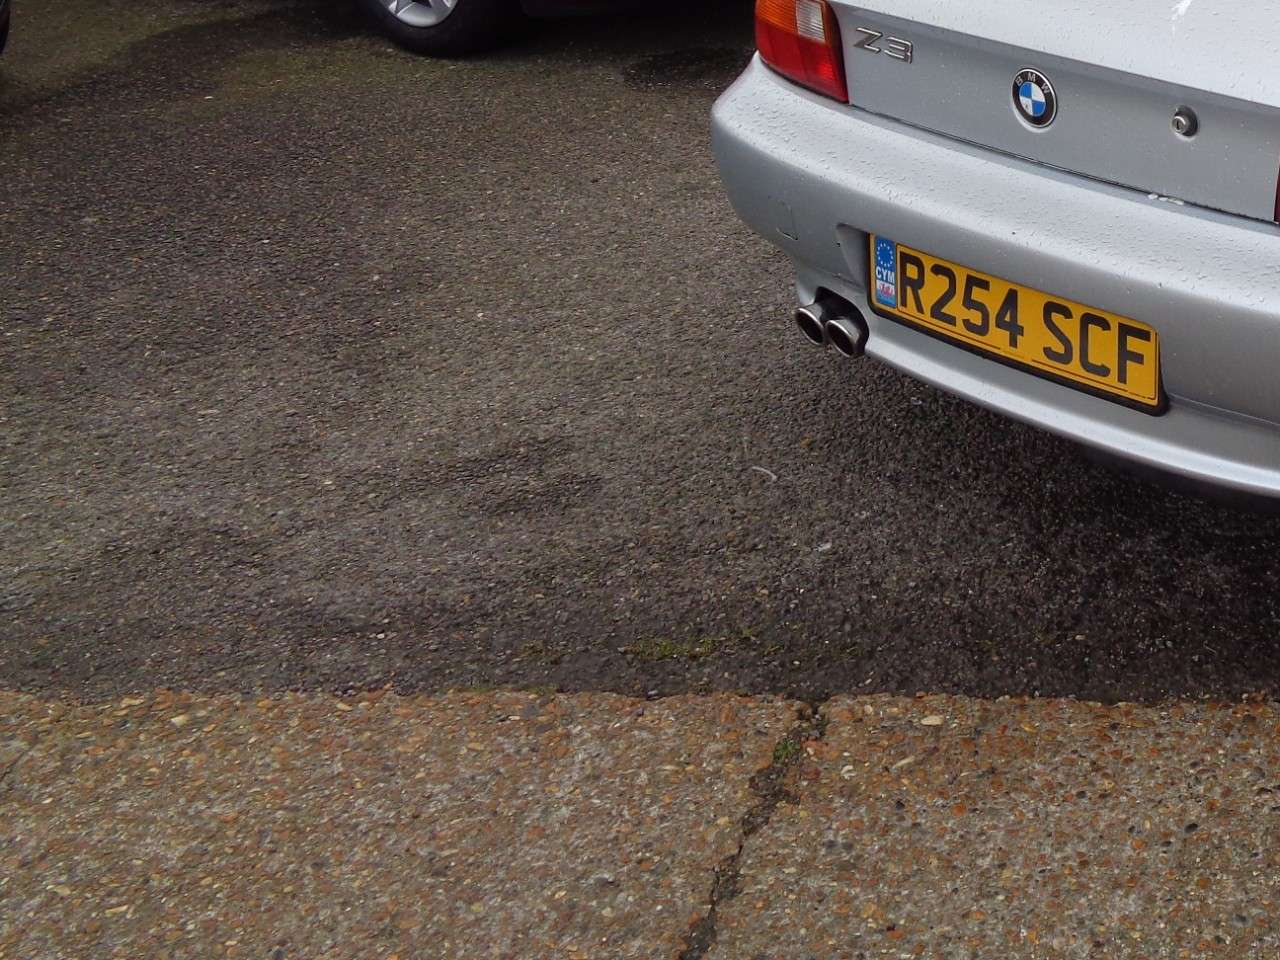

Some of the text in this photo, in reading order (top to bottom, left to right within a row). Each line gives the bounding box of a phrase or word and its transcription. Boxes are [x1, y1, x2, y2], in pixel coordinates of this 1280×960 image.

[854, 27, 913, 64] Z3
[1014, 71, 1050, 94] BMW
[875, 266, 895, 284] CYM
[900, 251, 1151, 384] R254 SCF
